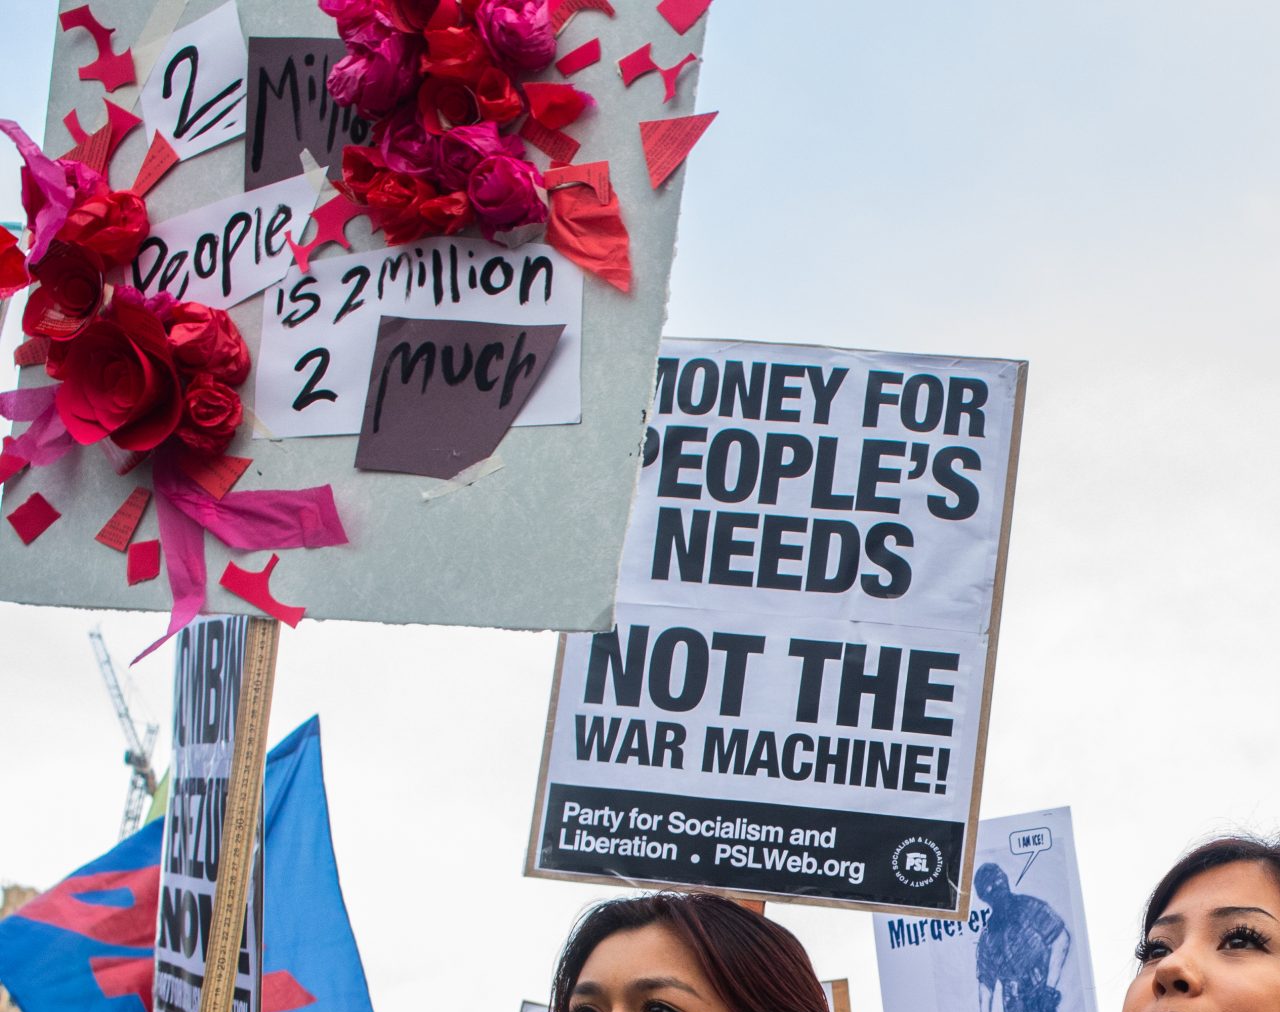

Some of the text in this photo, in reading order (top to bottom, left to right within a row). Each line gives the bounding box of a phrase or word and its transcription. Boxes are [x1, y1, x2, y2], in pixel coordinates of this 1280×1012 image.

[163, 45, 243, 138] 2
[254, 53, 375, 172] Millio
[332, 266, 380, 325] 2
[292, 348, 338, 411] 2
[862, 370, 989, 438] FOR
[651, 506, 915, 599] NEEDS
[584, 624, 961, 737] NOT THE
[575, 714, 951, 795] WAR MACHINE!
[562, 801, 837, 848] Party for Socialism and
[892, 836, 916, 870] SOCIALISM
[558, 828, 866, 885] Liberation PSLWeb.org
[895, 871, 909, 885] FOR
[905, 852, 930, 872] PSL
[910, 877, 934, 888] PARTY
[924, 838, 943, 878] LIBERATION
